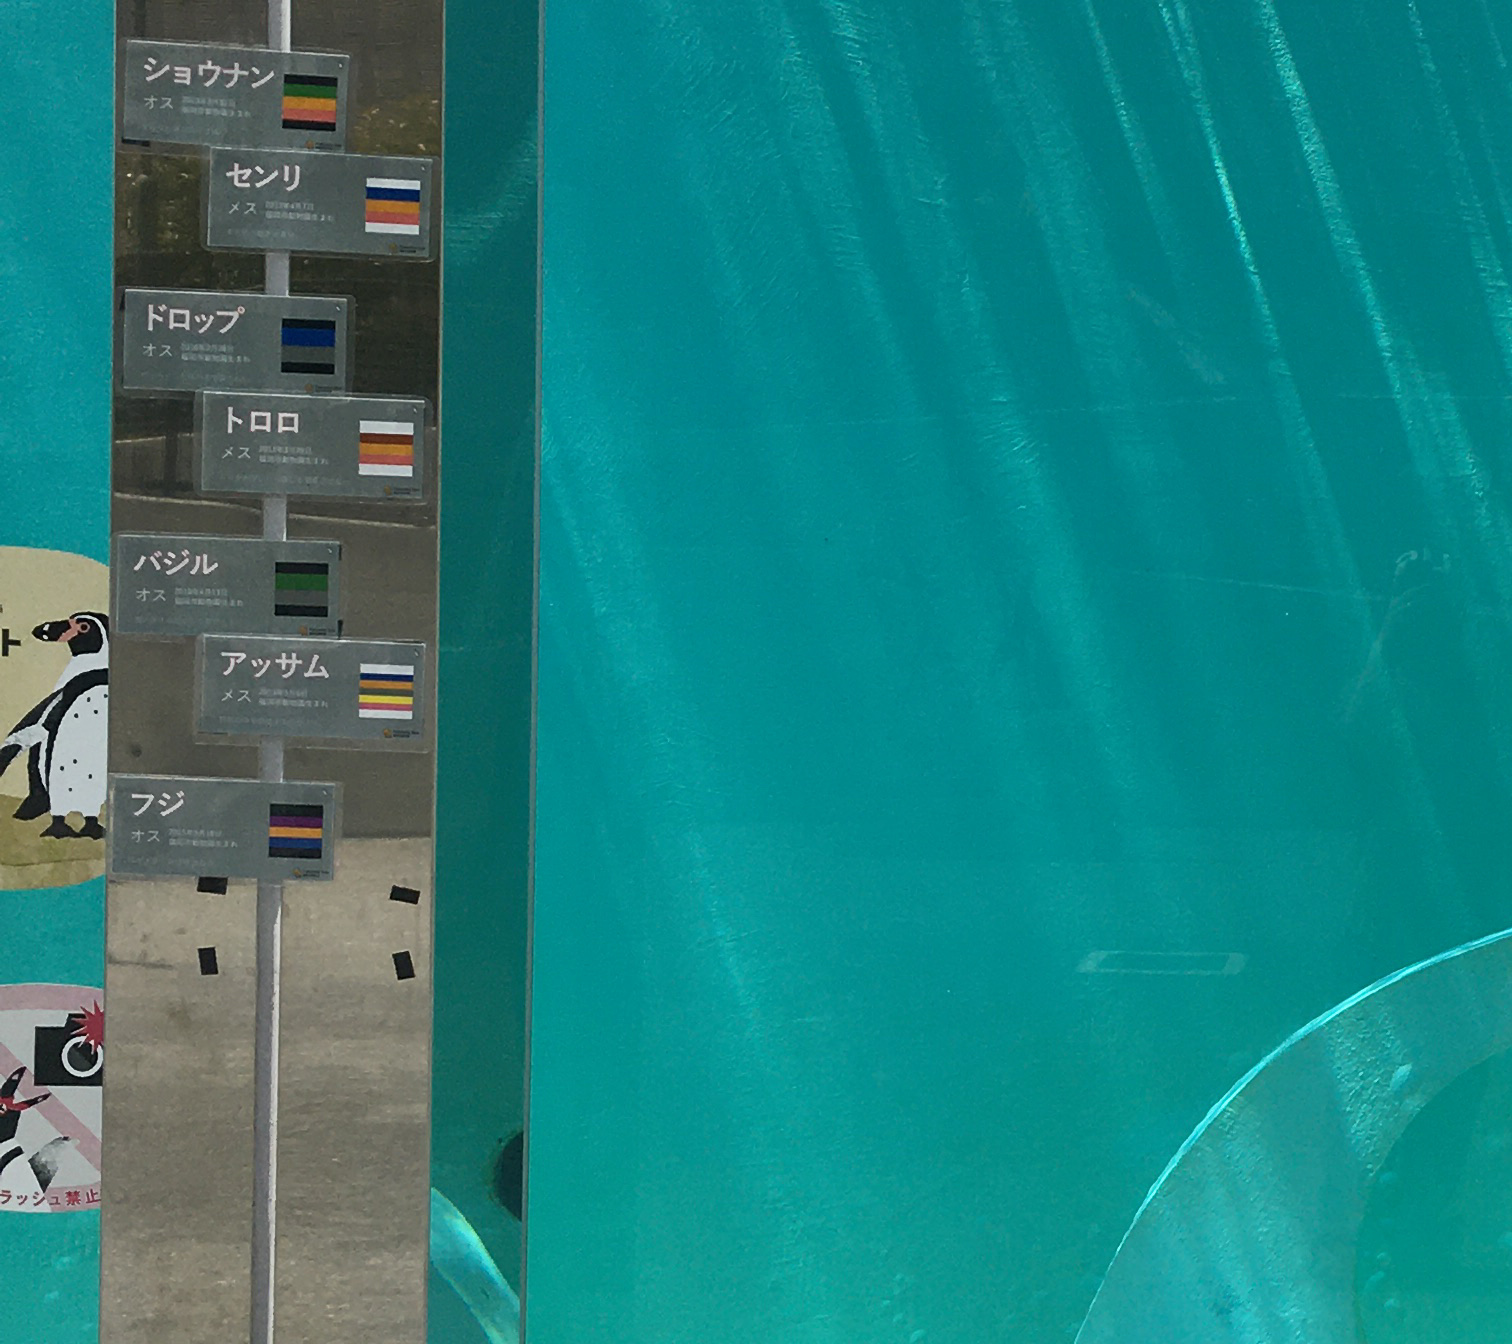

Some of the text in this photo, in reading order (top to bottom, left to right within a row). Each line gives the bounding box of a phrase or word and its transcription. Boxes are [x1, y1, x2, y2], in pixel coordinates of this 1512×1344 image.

[142, 57, 275, 89] ショウナン
[143, 95, 174, 110] オス
[225, 162, 301, 191] センリ
[229, 200, 258, 215] メス
[147, 304, 246, 334] ドロップ
[143, 343, 174, 358] オス
[226, 406, 300, 434] トロロ
[221, 446, 252, 460] メス
[133, 549, 219, 576] バジル
[136, 587, 167, 603] オス
[220, 651, 330, 679] アッサム
[220, 689, 252, 704] メス
[131, 791, 186, 817] フジ
[131, 828, 161, 843] オス
